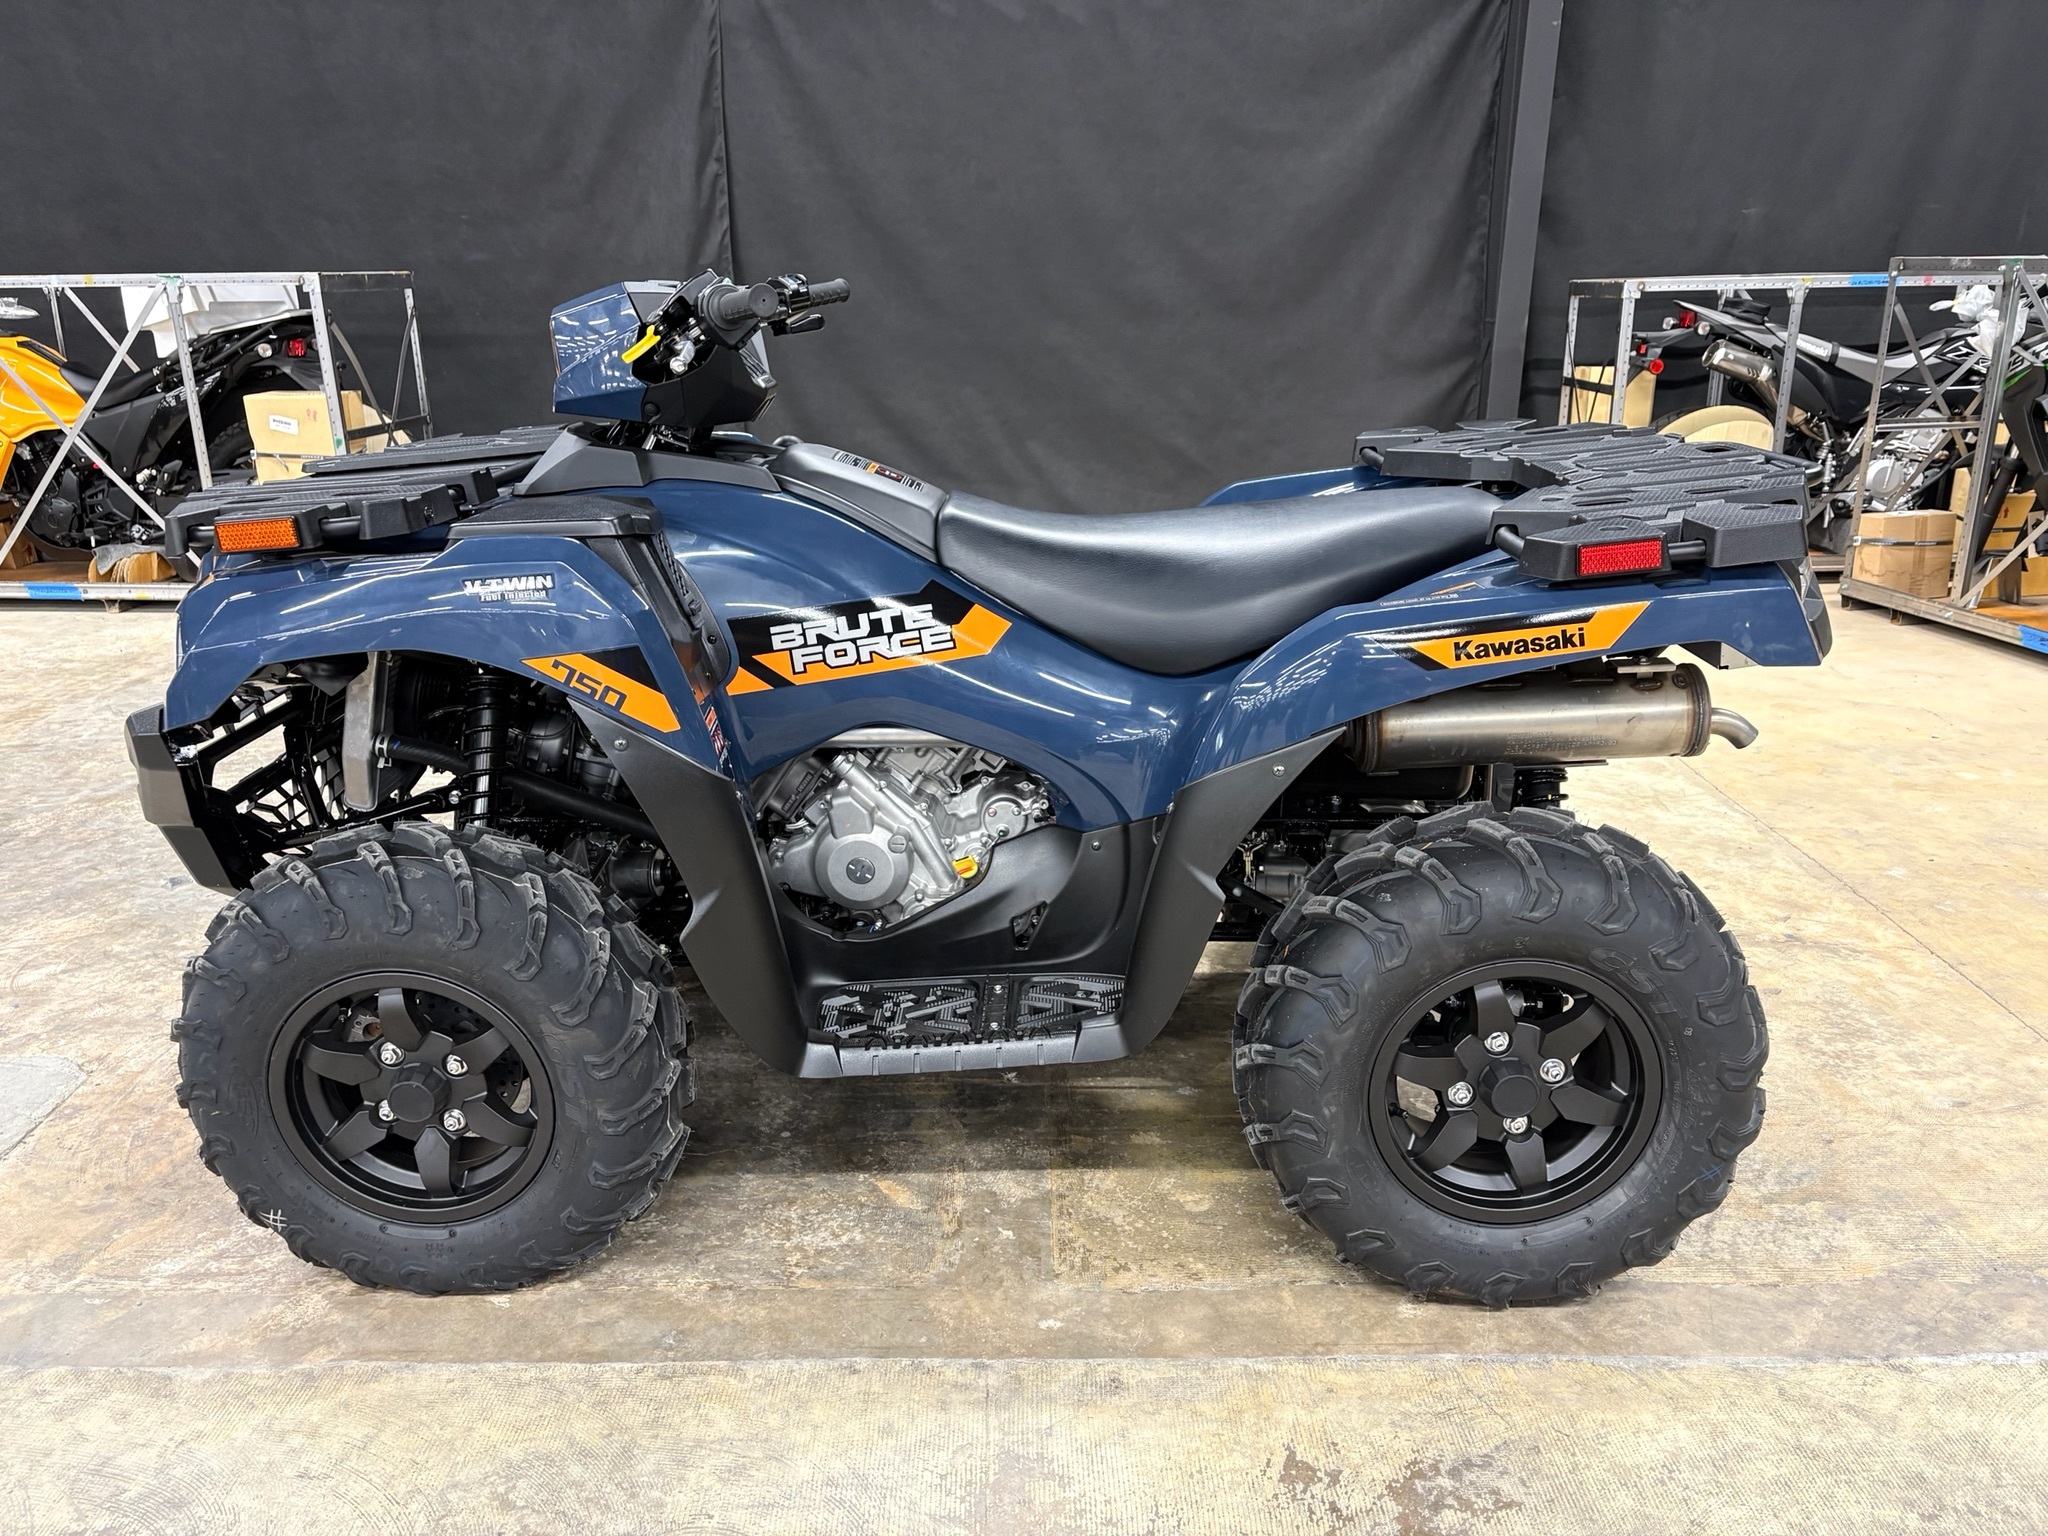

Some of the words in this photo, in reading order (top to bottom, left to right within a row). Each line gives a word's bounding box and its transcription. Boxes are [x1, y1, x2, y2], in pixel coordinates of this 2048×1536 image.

[1797, 338, 1829, 357] awasaki
[769, 603, 938, 650] BRUTE
[790, 624, 955, 674] FORCE
[1453, 627, 1586, 662] Kawasaki
[551, 658, 628, 711] 750
[1588, 947, 1689, 1020] CST
